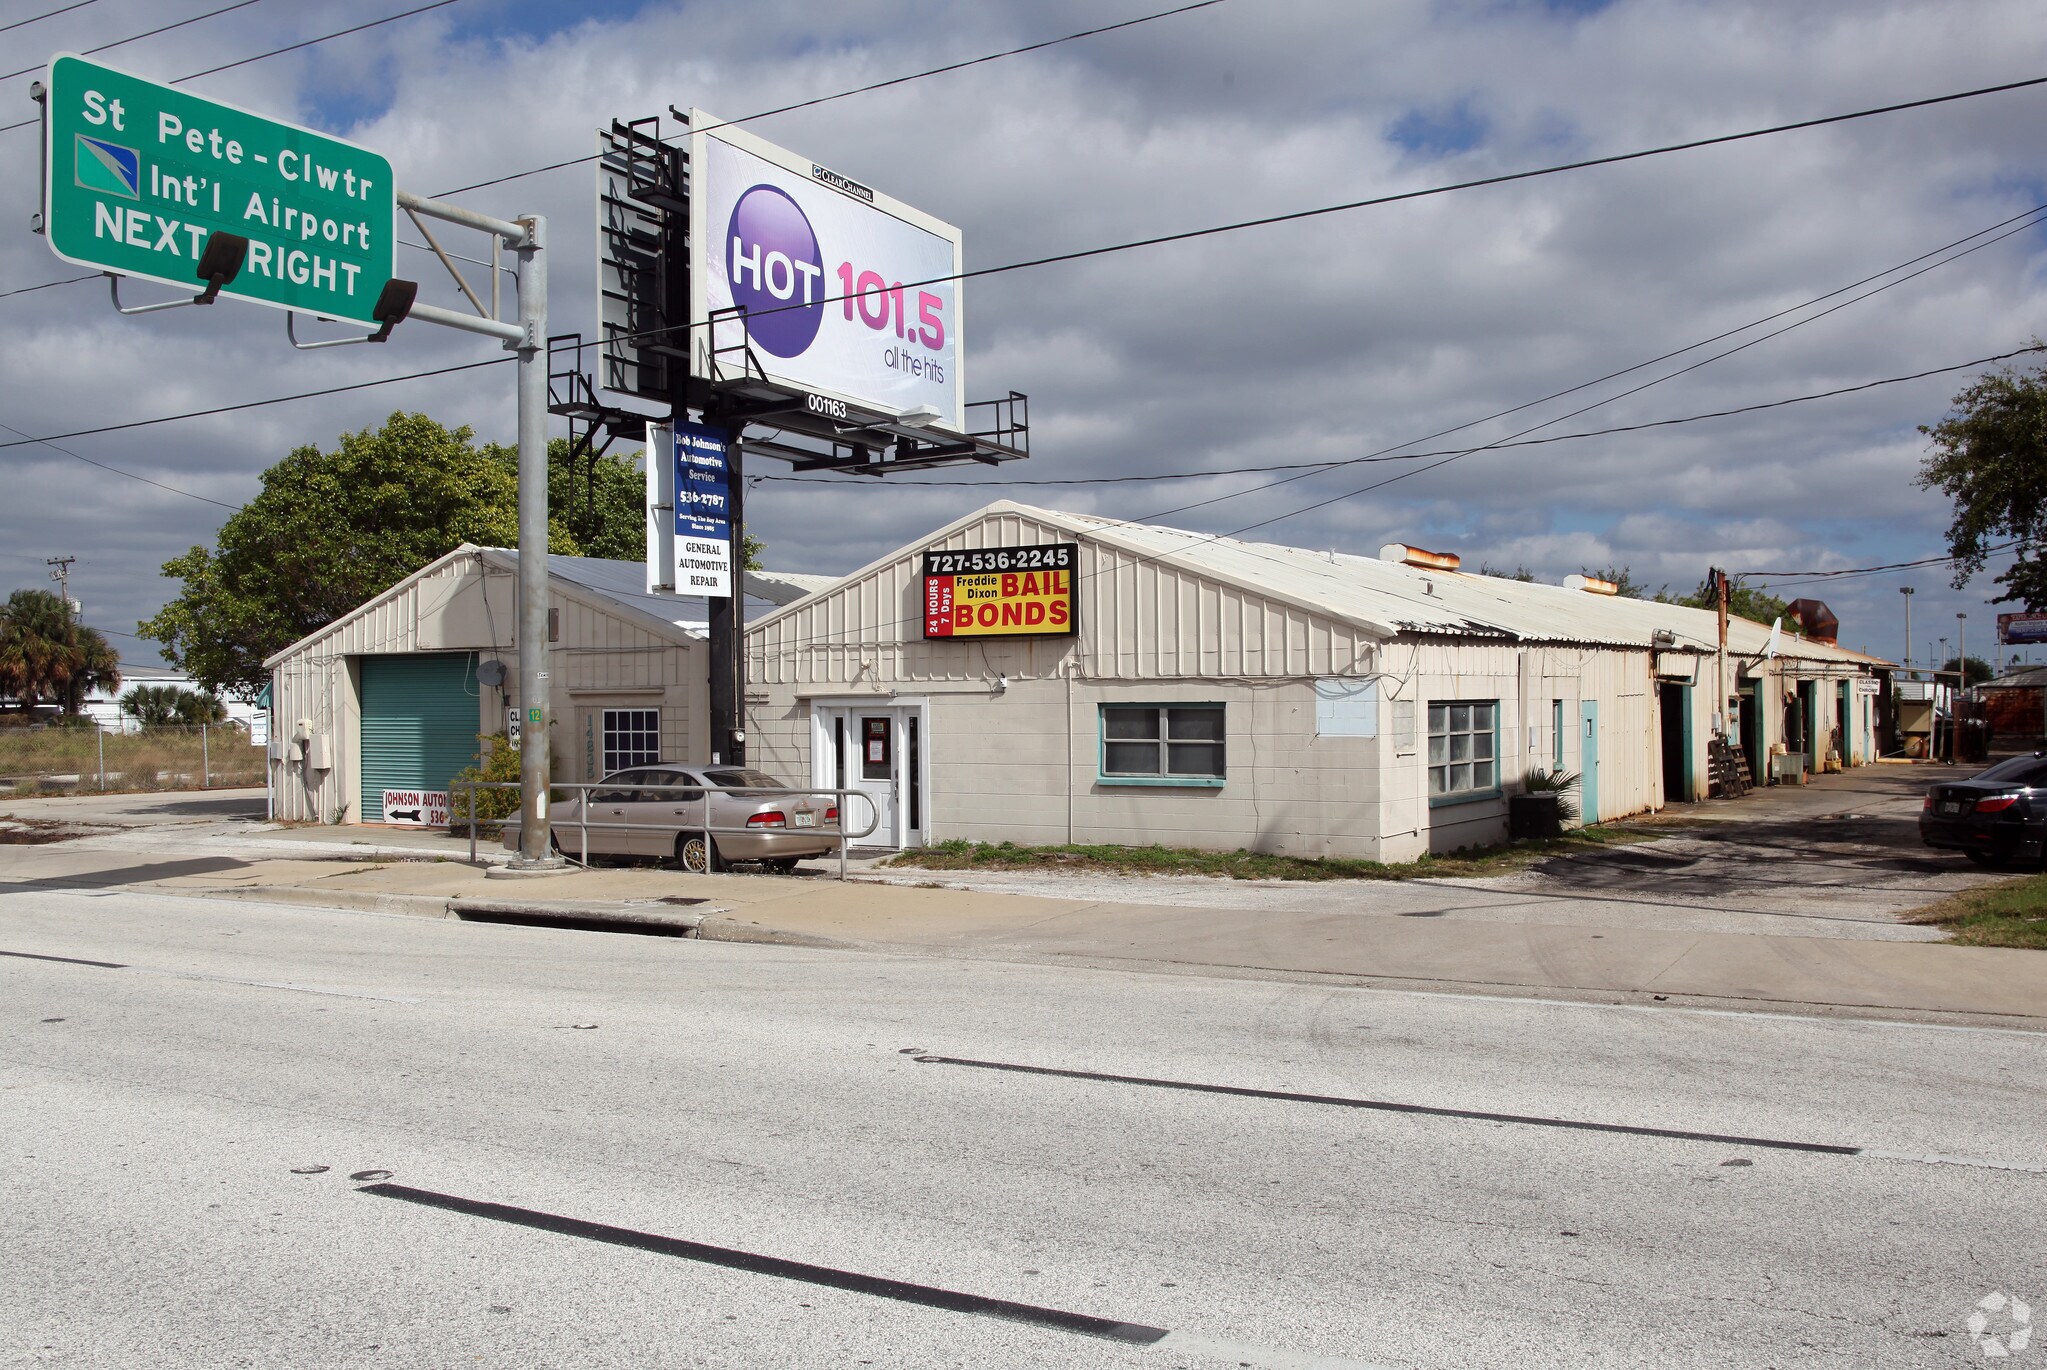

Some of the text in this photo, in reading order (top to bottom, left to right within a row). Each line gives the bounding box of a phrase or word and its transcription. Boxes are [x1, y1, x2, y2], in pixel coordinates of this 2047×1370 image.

[82, 90, 125, 132] St
[151, 164, 370, 251] Int'l Airport
[95, 200, 361, 296] NEXT RIGHT
[732, 236, 945, 351] HOT 101.5
[884, 346, 944, 384] all the hits
[808, 394, 847, 418] 001163
[675, 433, 726, 453] Bob Johnson's
[680, 451, 723, 468] Automotive
[688, 469, 716, 483] Service
[680, 490, 725, 508] 536-2787
[679, 513, 697, 522] Serving
[686, 542, 721, 556] GENERAL
[679, 558, 728, 572] AUTOMOTIVE
[929, 548, 1069, 573] 727-536-2245
[690, 575, 718, 587] REPAIR
[956, 571, 1068, 597] Freddie BAIL
[941, 587, 952, 613] Days
[967, 588, 998, 600] Dixon
[929, 579, 939, 633] 24 HOURS
[955, 600, 1068, 628] BONDS
[530, 710, 541, 721] 12
[385, 792, 419, 808] JOHNSON
[430, 809, 445, 824] 536
